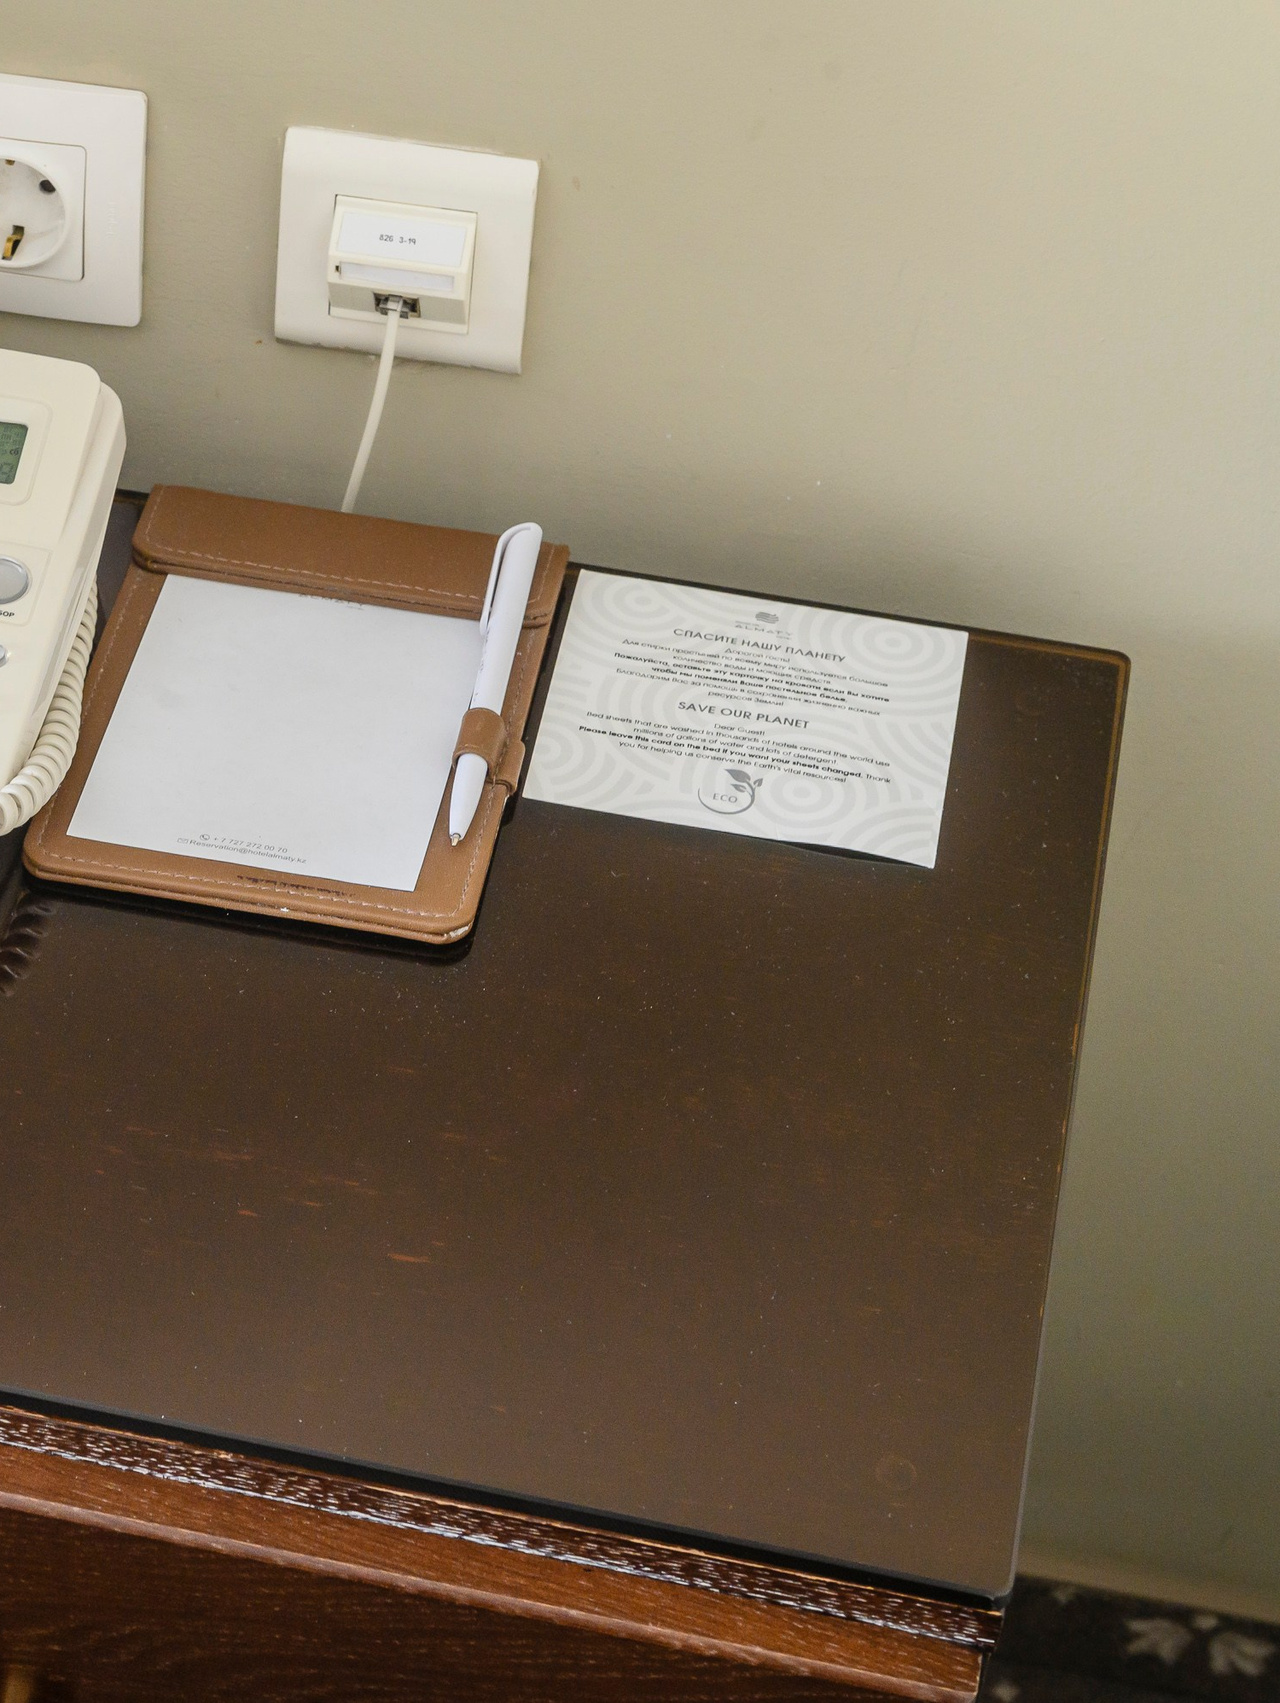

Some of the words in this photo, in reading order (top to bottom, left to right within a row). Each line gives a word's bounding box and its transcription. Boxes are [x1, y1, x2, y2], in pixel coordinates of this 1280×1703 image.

[379, 234, 394, 243] 826
[622, 638, 640, 646] Для
[673, 629, 737, 645] СПАСИТЕ
[741, 639, 782, 651] НАШУ
[785, 646, 846, 662] ПЛАНЕТУ
[651, 667, 678, 675] чтобы
[678, 702, 716, 714] SAVE
[720, 708, 752, 720] OUR
[756, 713, 809, 729] PLANET
[714, 723, 735, 731] Dear
[586, 711, 604, 719] Bed
[605, 715, 632, 724] sheets
[634, 719, 652, 727] that
[670, 726, 705, 734] washed
[716, 731, 759, 743] thousands
[772, 741, 798, 749] hotels
[799, 746, 832, 755] around
[849, 755, 874, 764] world
[633, 728, 663, 737] millions
[676, 735, 707, 743] gallons
[579, 725, 607, 735] Please
[609, 730, 633, 739] leave
[702, 745, 721, 753] bed
[792, 761, 819, 770] sheets
[821, 766, 864, 778] changed.
[866, 774, 891, 784] Thank
[650, 746, 683, 756] helping
[695, 753, 735, 763] conserve
[802, 771, 847, 783] resources!
[712, 793, 738, 803] ECO
[189, 839, 307, 864] Reservation@hotelalmaty.kz
[229, 838, 244, 846] 727
[246, 840, 261, 849] 272
[264, 843, 275, 851] 00
[277, 846, 288, 854] 70
